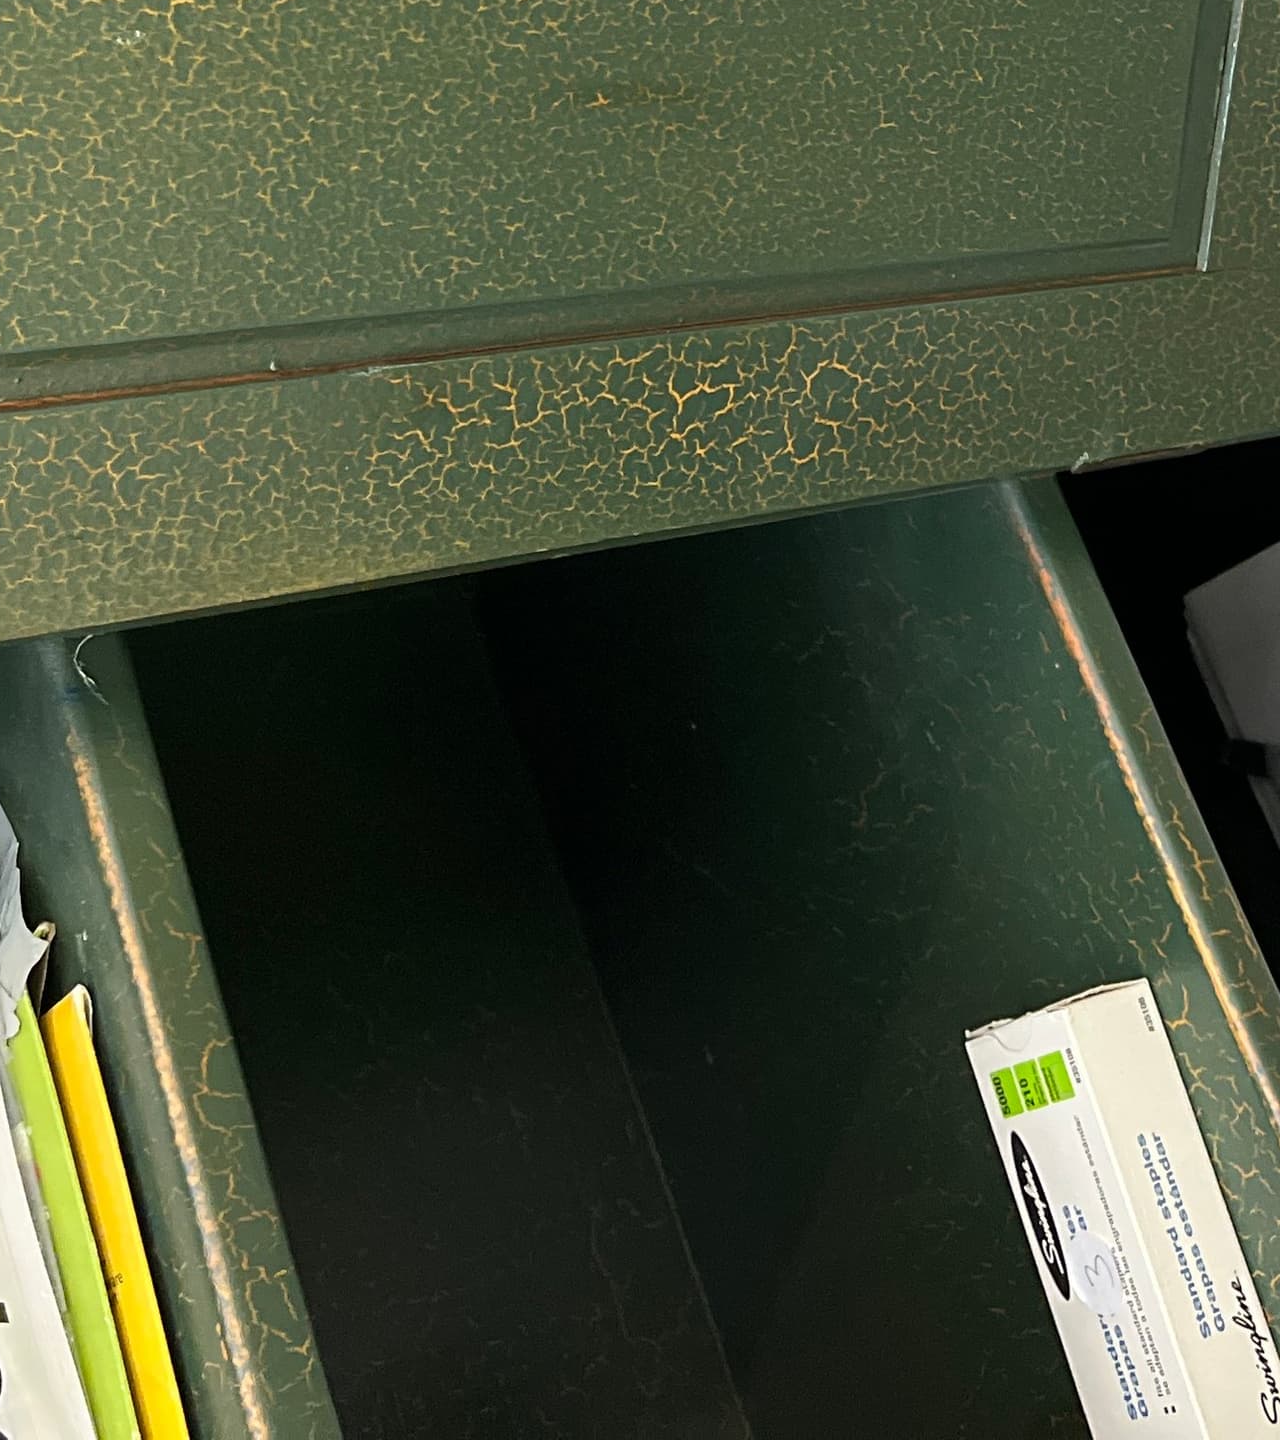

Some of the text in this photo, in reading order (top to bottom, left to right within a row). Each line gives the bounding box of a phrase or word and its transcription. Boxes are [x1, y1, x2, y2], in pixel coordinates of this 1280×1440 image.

[991, 1075, 1012, 1116] 5000
[1019, 1077, 1036, 1108] 210
[1137, 1132, 1212, 1340] Standard staples
[1152, 1131, 1226, 1333] Grapas estándar
[1084, 1253, 1116, 1289] 3
[1113, 1323, 1149, 1418] Grapas
